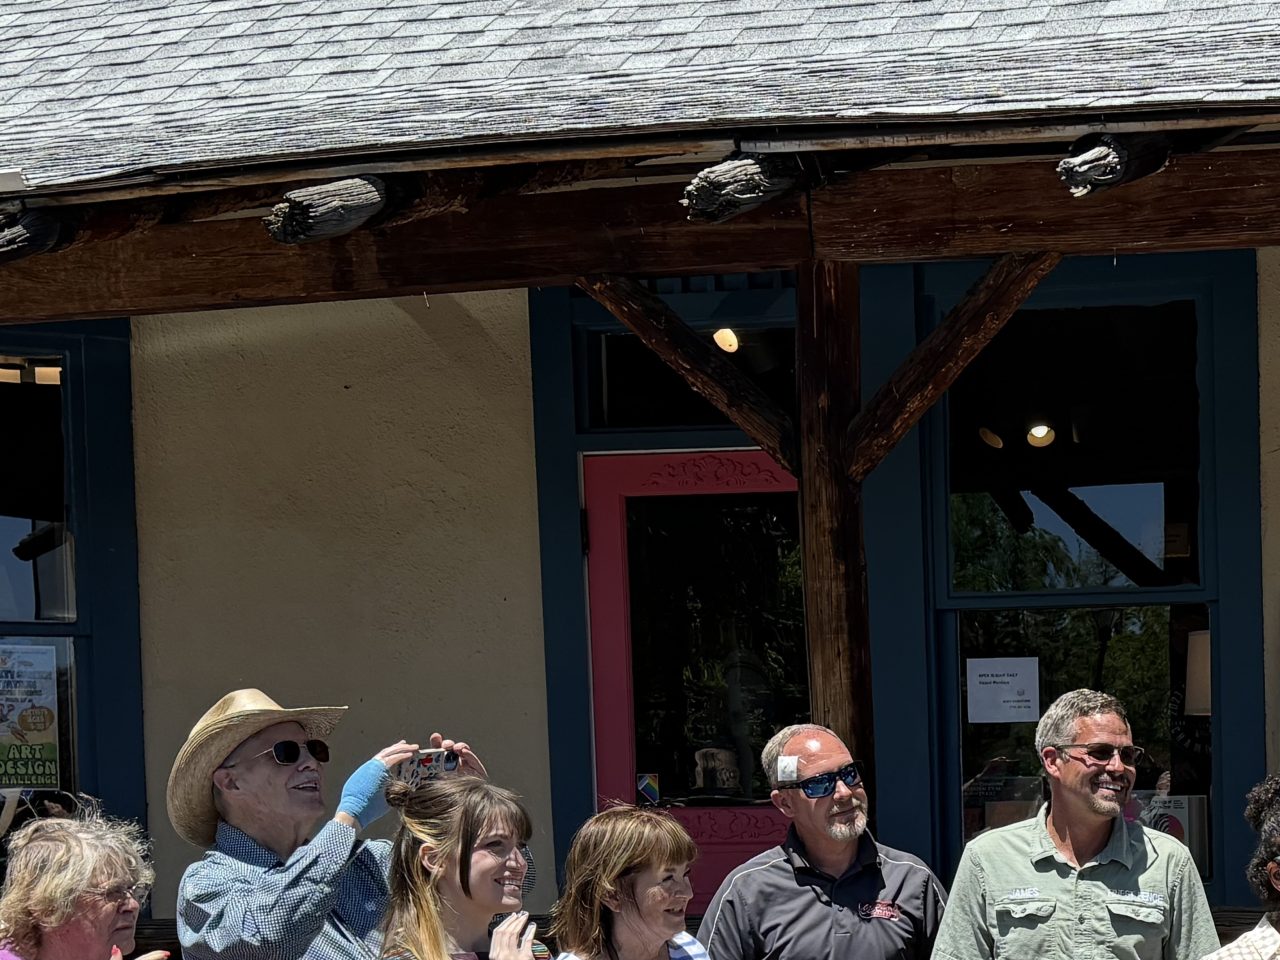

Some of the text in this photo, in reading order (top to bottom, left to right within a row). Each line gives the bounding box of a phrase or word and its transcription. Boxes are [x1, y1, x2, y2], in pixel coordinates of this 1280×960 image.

[7, 744, 44, 760] ART
[0, 775, 57, 784] HALLENGE
[1008, 887, 1041, 898] JAMES
